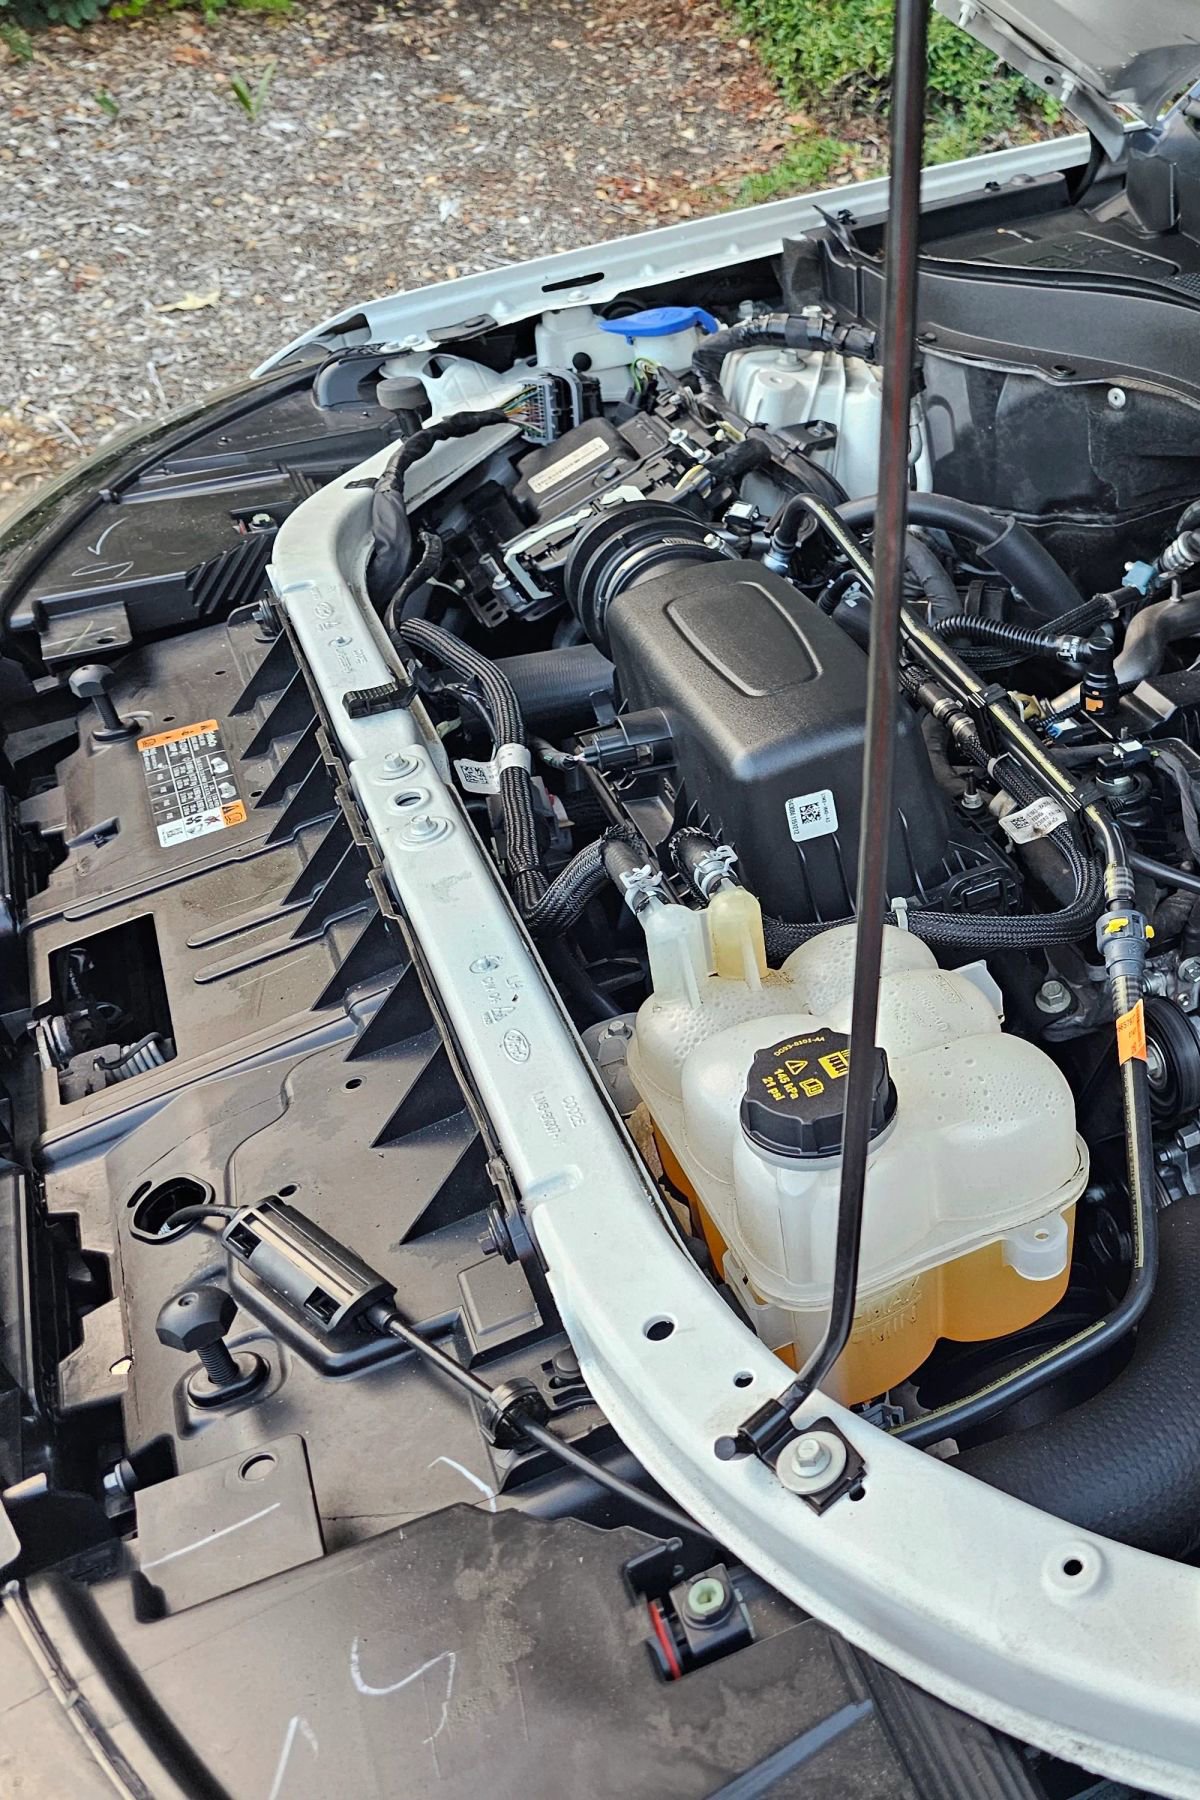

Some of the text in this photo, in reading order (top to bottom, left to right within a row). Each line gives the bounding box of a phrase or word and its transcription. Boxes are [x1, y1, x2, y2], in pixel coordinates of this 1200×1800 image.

[762, 1076, 786, 1101] 21 psi
[774, 1068, 799, 1100] 145 kPa
